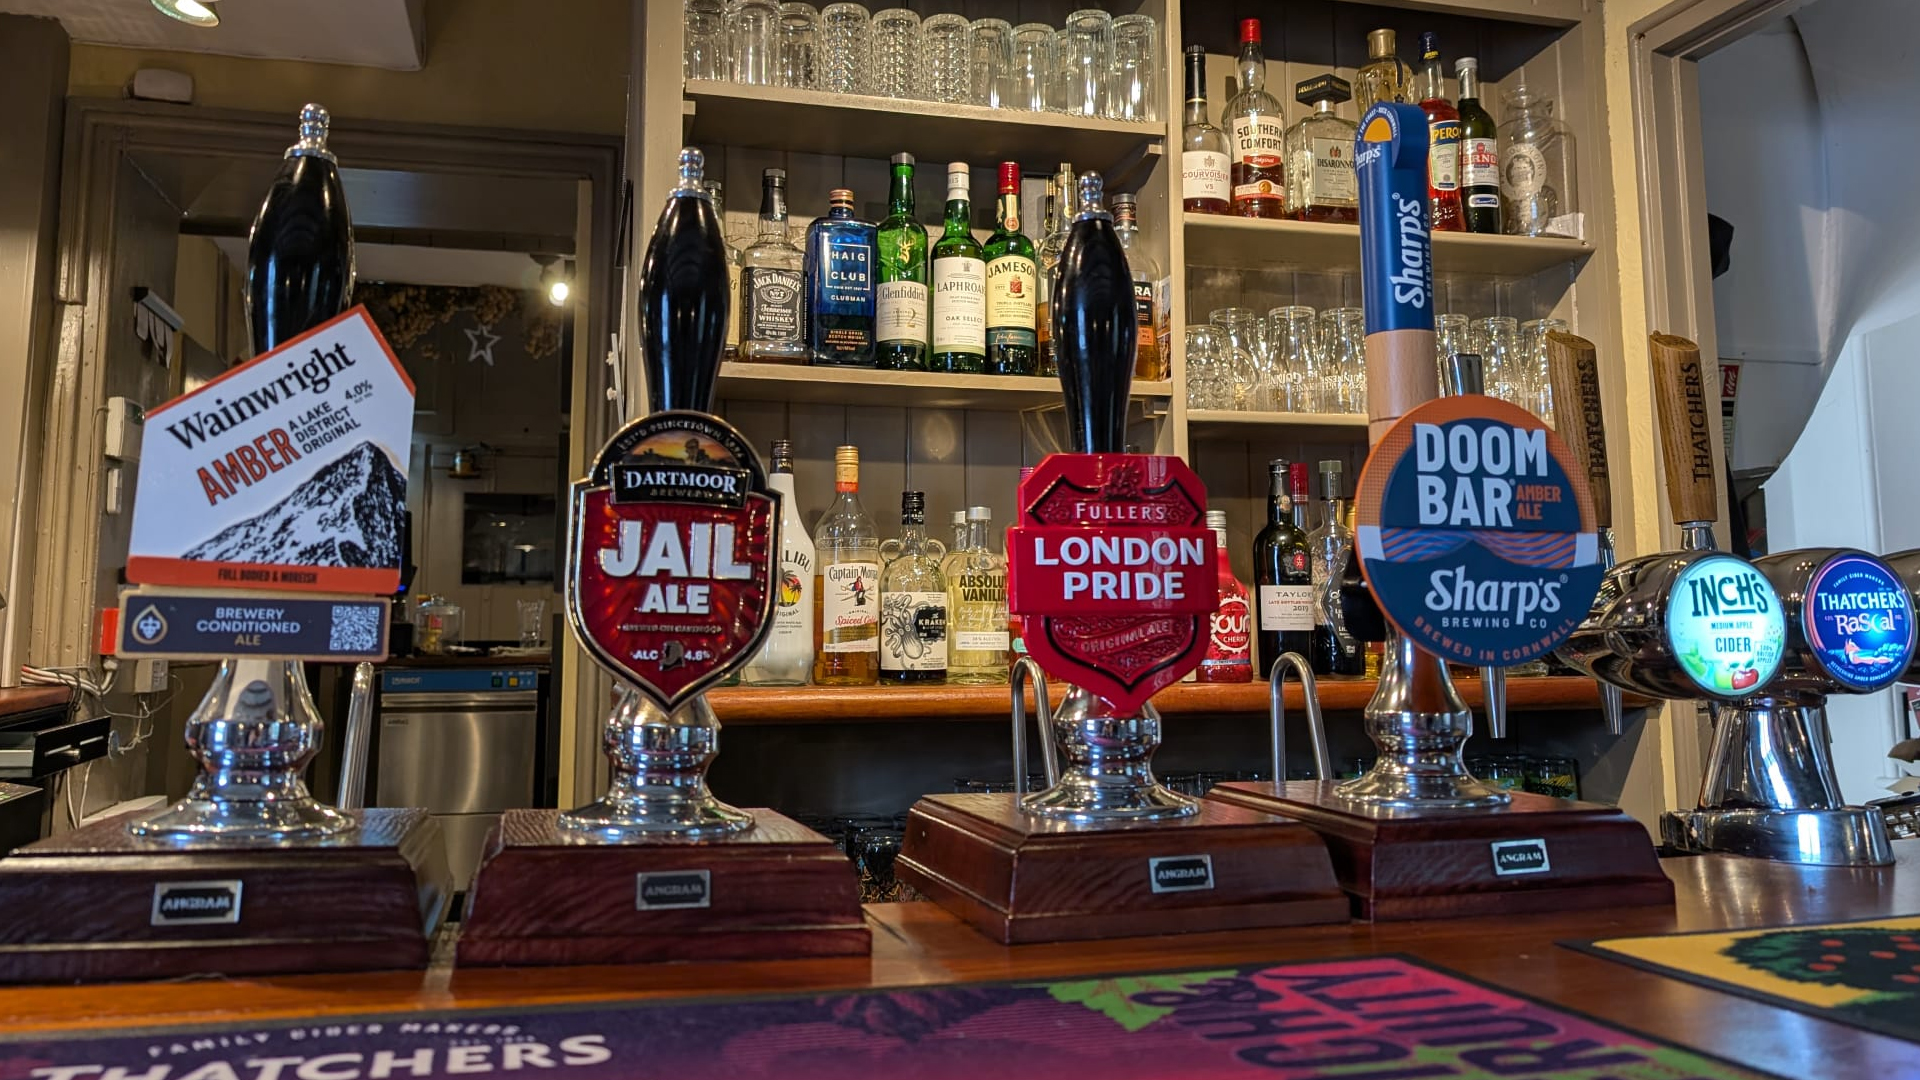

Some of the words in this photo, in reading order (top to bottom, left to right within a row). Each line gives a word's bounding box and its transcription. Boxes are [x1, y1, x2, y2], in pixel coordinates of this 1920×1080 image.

[1237, 124, 1282, 138] SOUTHERN
[1241, 137, 1281, 151] COMFORT
[831, 251, 866, 262] HAIG
[1390, 198, 1428, 308] Sharp's
[753, 275, 771, 289] JACK
[831, 272, 866, 282] CLUB
[165, 341, 356, 451] Wainwright
[345, 379, 373, 400] 4.0%
[288, 420, 299, 432] A
[298, 401, 333, 426] LAKE
[294, 405, 351, 443] DISTRICT
[1577, 358, 1606, 483] THATCHERS
[1682, 362, 1711, 483] THATCHERS
[302, 418, 361, 455] ORIGINAL
[1414, 423, 1548, 477] DOOM
[197, 426, 302, 506] AMBER
[625, 471, 736, 494] DARTMOOR
[1417, 474, 1513, 527] BAR
[1516, 484, 1562, 503] AMBER
[1516, 503, 1543, 520] ALE
[598, 519, 752, 581] JAIL
[1034, 536, 1204, 566] LONDON
[829, 566, 859, 582] Captain
[1063, 571, 1185, 601] PRIDE
[641, 583, 710, 615] ALE
[1424, 565, 1561, 625] Sharp's
[1688, 573, 1768, 617] INCH'S
[1817, 590, 1906, 611] THATCHERS
[196, 620, 300, 633] CONDITIONED
[215, 607, 285, 620] BREWERY
[1442, 617, 1510, 629] BREWING
[1529, 618, 1547, 629] CO
[1711, 622, 1734, 630] MEDIUM
[1736, 621, 1753, 630] APPLE
[234, 634, 262, 646] ALE
[1081, 627, 1146, 653] ORIGINAL
[1147, 620, 1170, 635] ALE
[1414, 616, 1473, 657] BREWED
[1479, 649, 1495, 661] IN
[1502, 618, 1576, 661] CORNWALL
[1715, 637, 1751, 653] CIDER
[632, 649, 659, 660] ALC
[1499, 851, 1543, 864] ANGRAM
[1253, 970, 1655, 1080] RUITY
[148, 1032, 270, 1057] FAMILY
[289, 1024, 383, 1040] CIDER
[30, 1035, 612, 1080] THATCHERS
